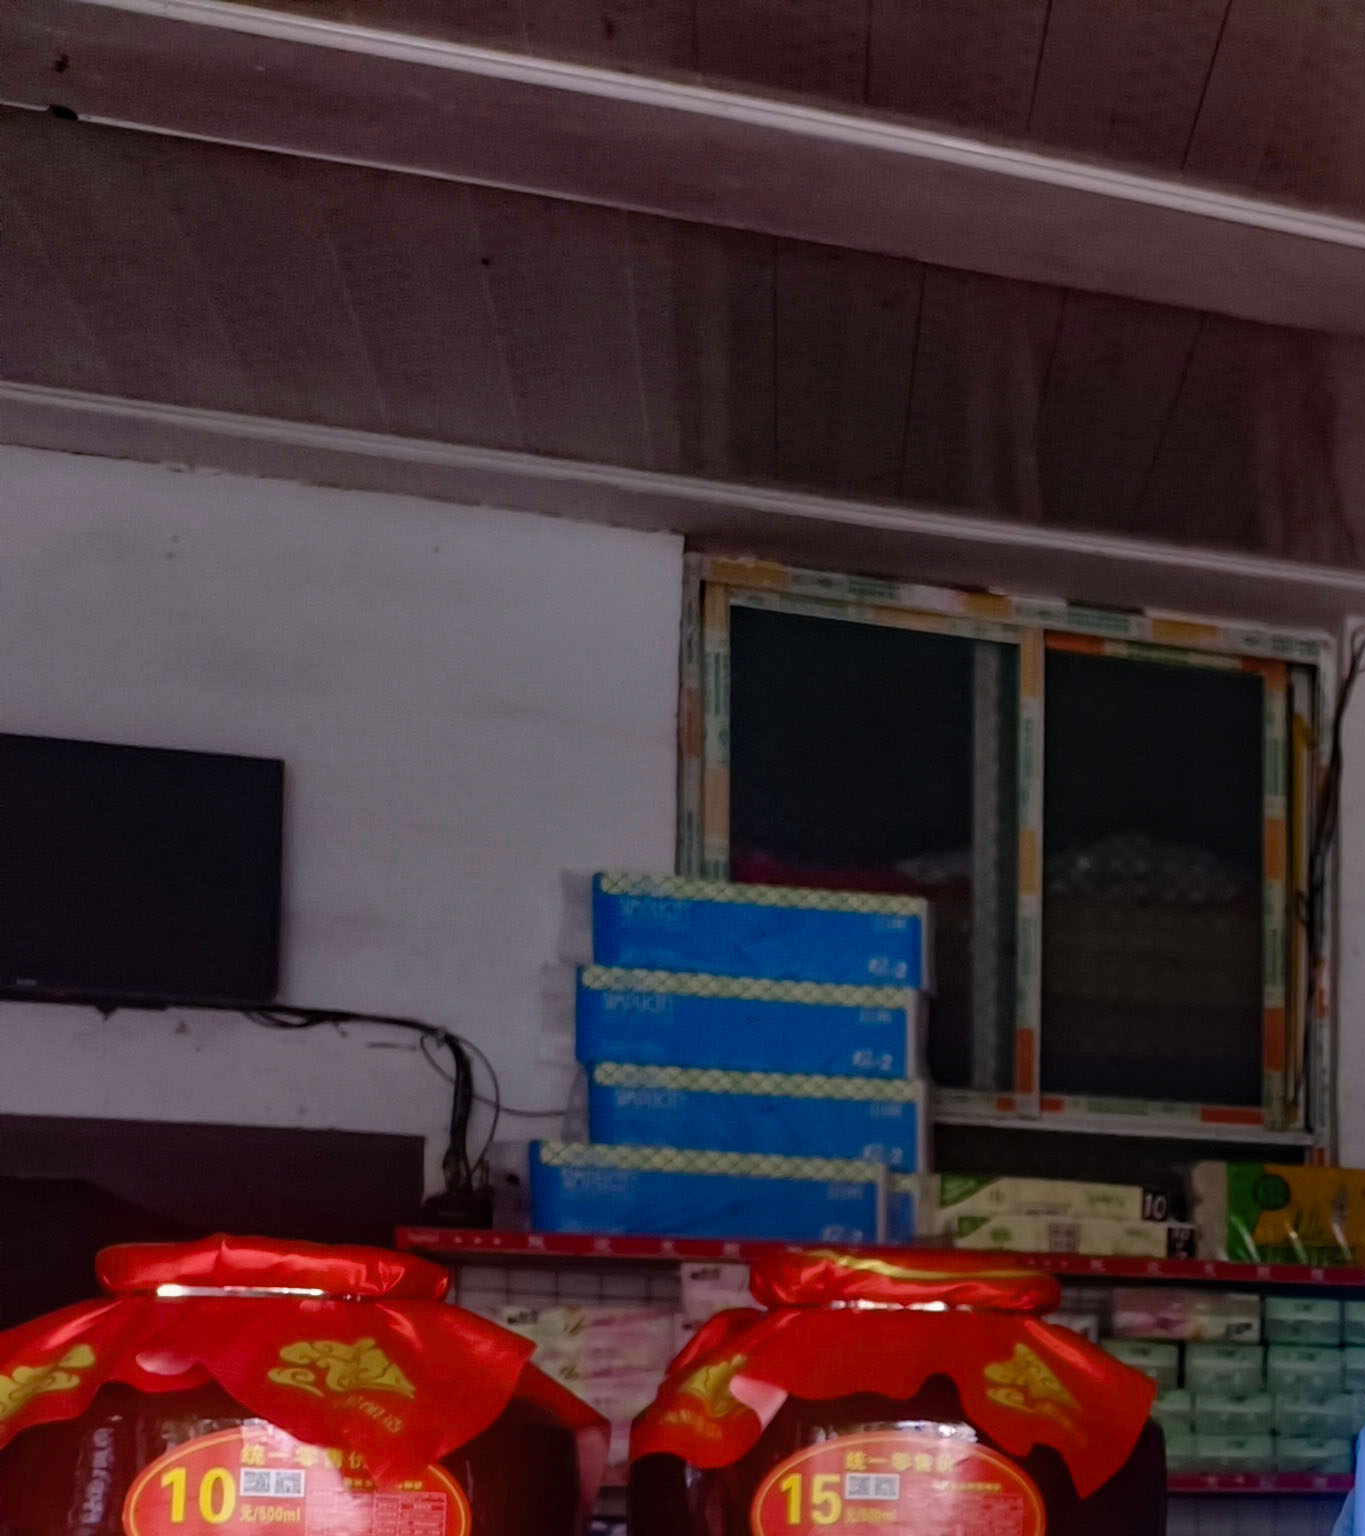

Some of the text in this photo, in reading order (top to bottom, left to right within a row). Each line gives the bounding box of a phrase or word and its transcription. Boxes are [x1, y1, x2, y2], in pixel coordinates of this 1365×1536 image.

[1142, 1193, 1166, 1220] 10
[159, 1466, 237, 1526] 10
[779, 1472, 844, 1527] 15
